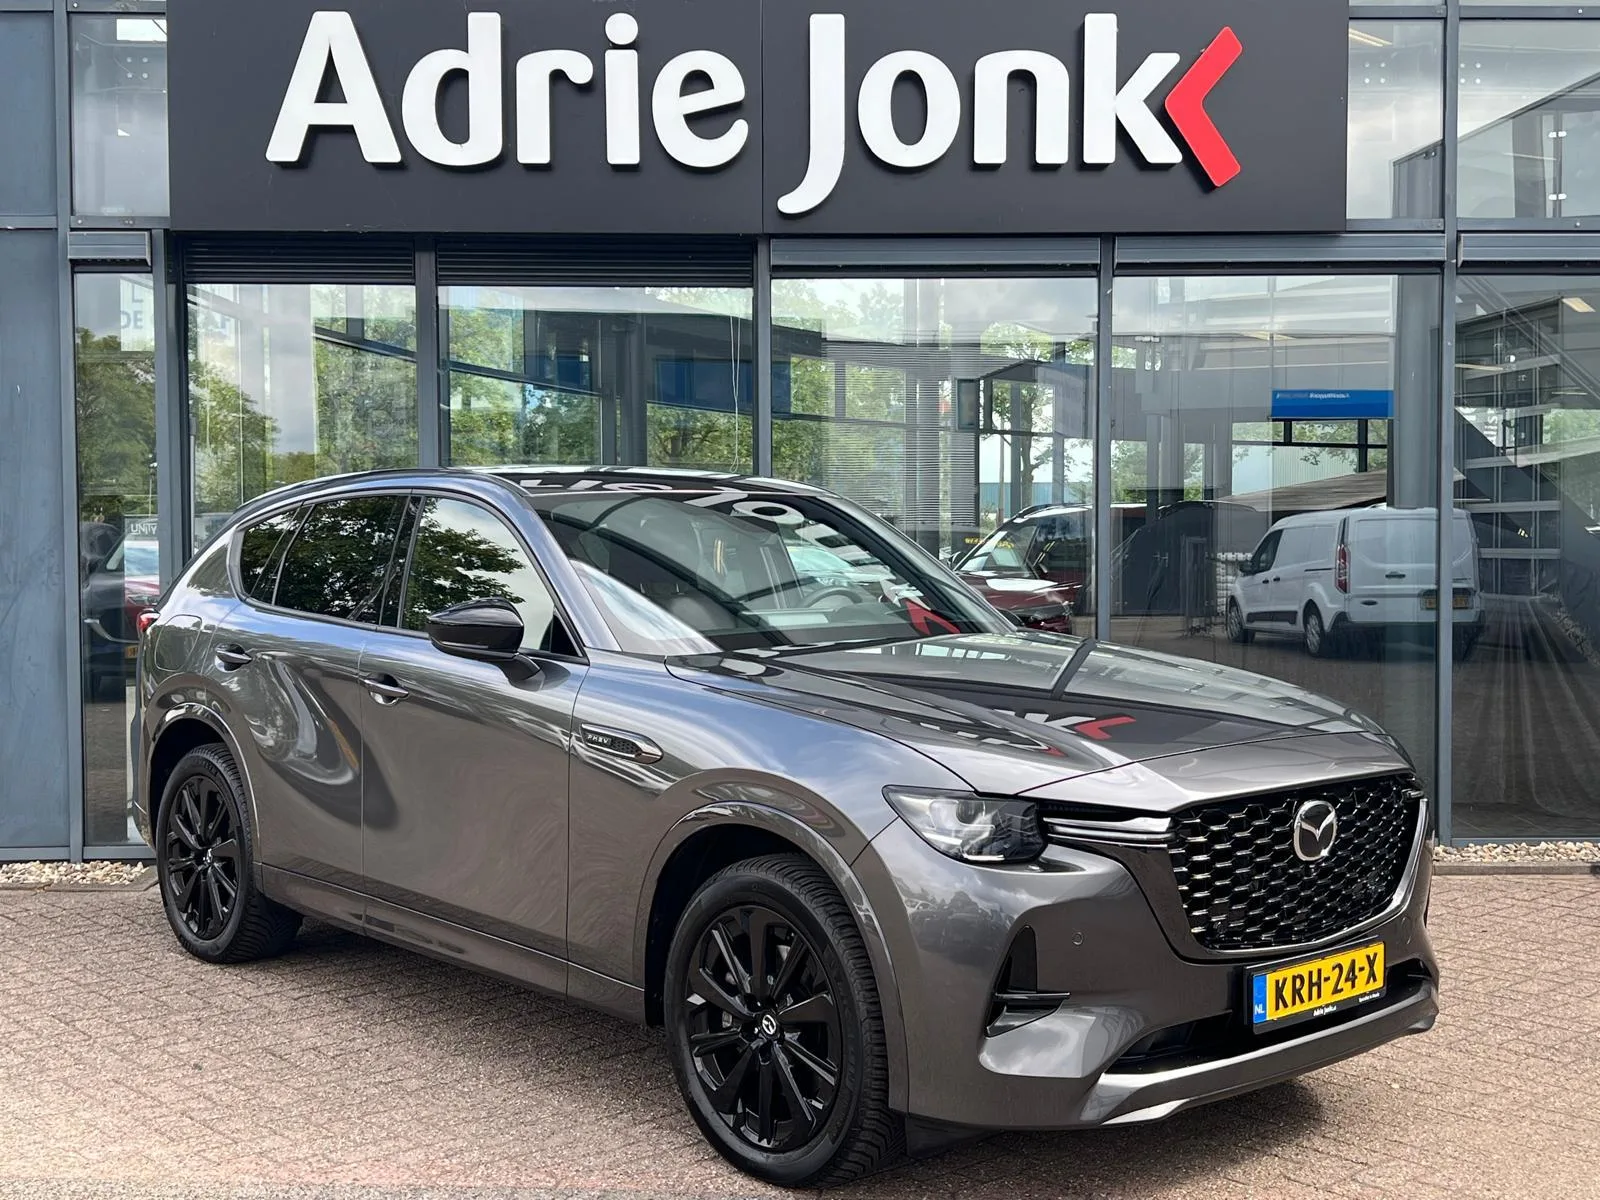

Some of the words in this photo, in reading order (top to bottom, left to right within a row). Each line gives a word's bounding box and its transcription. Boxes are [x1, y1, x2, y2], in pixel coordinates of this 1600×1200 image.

[265, 10, 749, 169] Adrie
[777, 12, 1185, 214] Jonk
[1254, 1003, 1265, 1015] NL
[1274, 952, 1378, 1012] KRH-24-X
